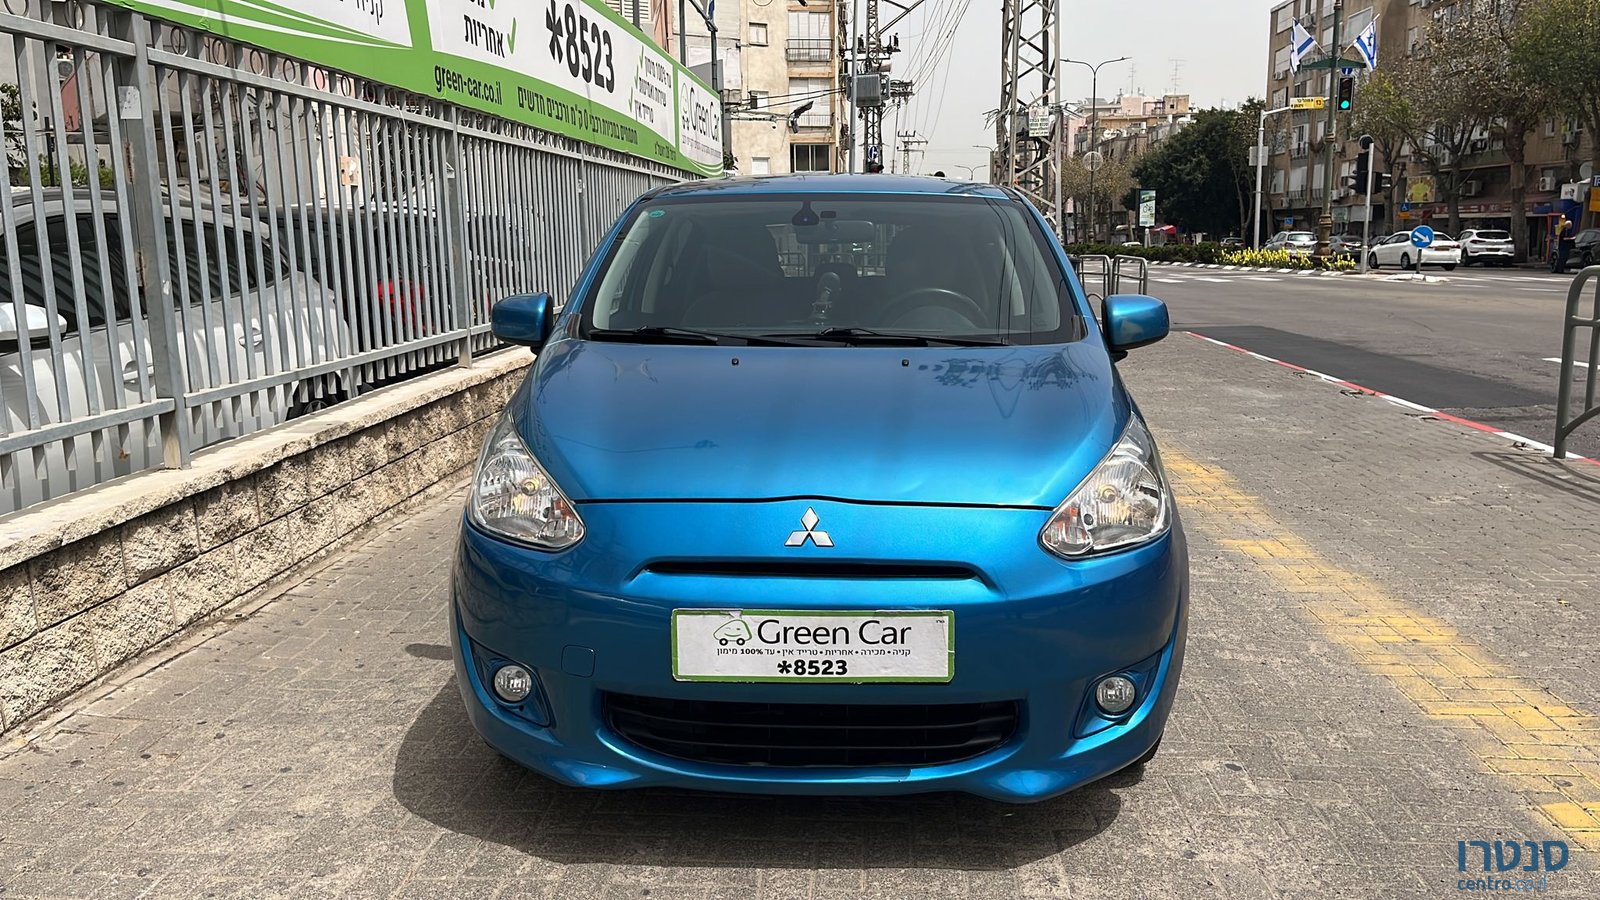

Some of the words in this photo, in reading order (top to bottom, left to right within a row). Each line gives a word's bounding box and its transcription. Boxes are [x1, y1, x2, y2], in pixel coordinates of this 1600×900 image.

[463, 14, 505, 58] אחריות
[434, 64, 503, 105] green-car.co.il
[517, 86, 546, 116] חדשים
[546, 97, 570, 124] ורכבים
[757, 619, 850, 645] Green
[858, 619, 912, 645] Car
[717, 648, 738, 656] מימון
[764, 648, 776, 656] עד
[782, 648, 794, 657] אין
[796, 648, 818, 656] טרייד
[824, 648, 854, 656] אחריות
[860, 648, 886, 656] מכירה
[892, 648, 911, 657] קניה
